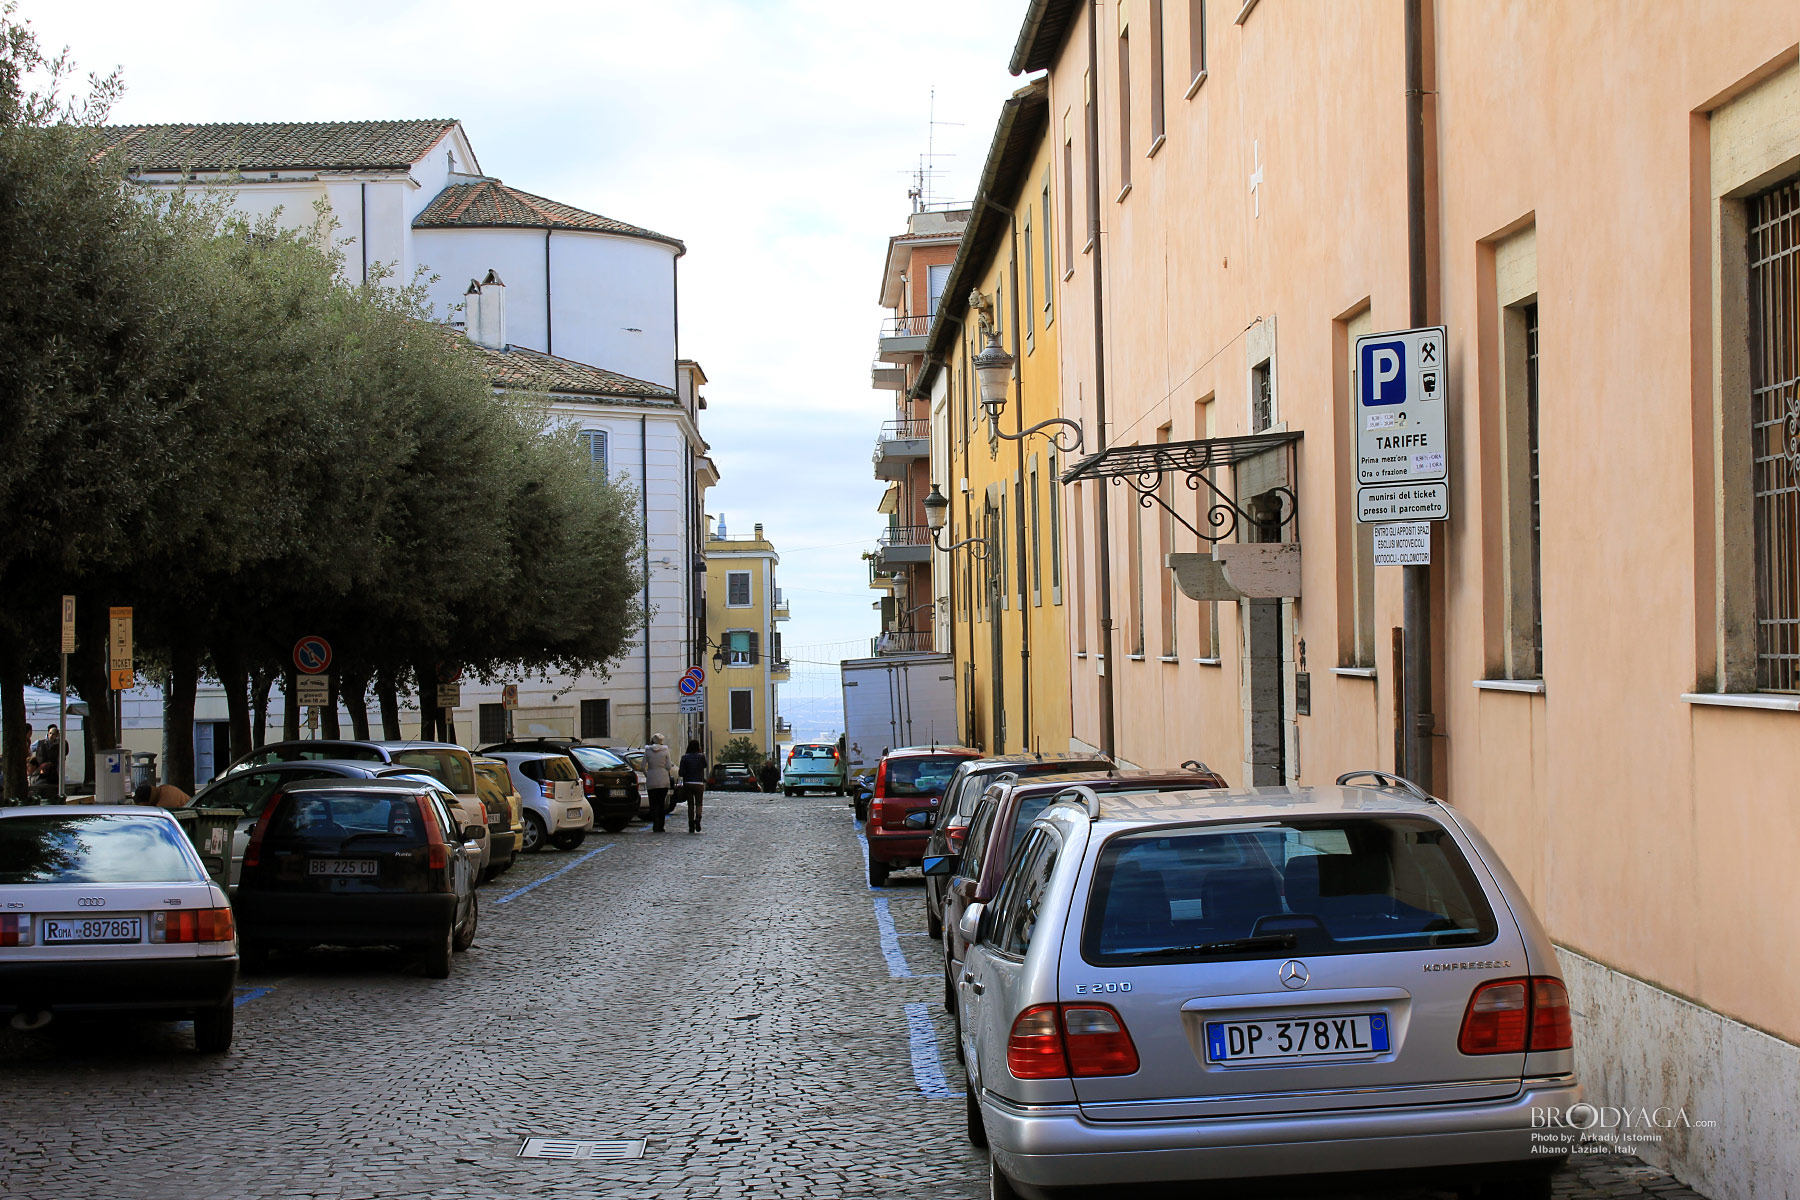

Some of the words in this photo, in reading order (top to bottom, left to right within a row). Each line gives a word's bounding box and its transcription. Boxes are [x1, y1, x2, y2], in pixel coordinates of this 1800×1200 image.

[1372, 348, 1400, 400] P
[1376, 434, 1428, 450] TARIFFE
[1382, 455, 1407, 463] mezz'ora
[1369, 492, 1395, 501] munirsi
[1399, 491, 1410, 499] del
[1414, 490, 1436, 499] ticket
[1364, 507, 1387, 516] presso
[1391, 505, 1396, 513] il
[1399, 503, 1441, 514] parcometro
[1375, 528, 1388, 536] ENTRO
[1397, 526, 1416, 535] APPOSITI
[1417, 526, 1429, 534] SPAZI
[1378, 540, 1395, 549] ESCLUSI
[1375, 554, 1397, 563] MOTOCICLI
[1400, 553, 1429, 562] CICLOMOTORI
[112, 659, 131, 668] TICKET
[312, 861, 326, 872] BB
[334, 861, 355, 873] 225
[360, 861, 375, 873] CD
[83, 920, 138, 938] 89786T
[1422, 960, 1512, 973] KOMPRESSOR
[1075, 984, 1088, 994] E
[1092, 982, 1132, 993] 200
[1228, 1024, 1263, 1056] DP
[1277, 1019, 1369, 1053] 378XL
